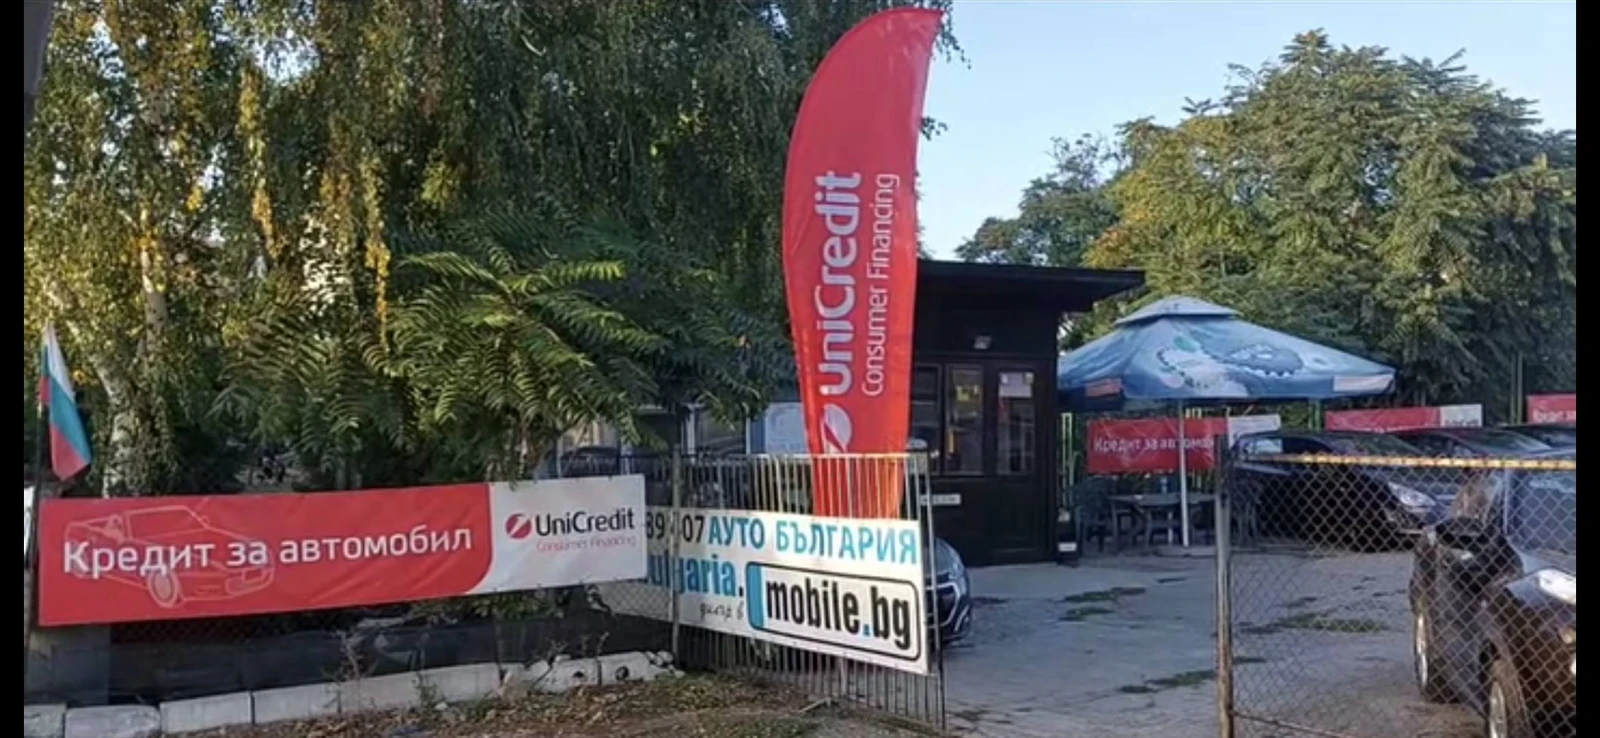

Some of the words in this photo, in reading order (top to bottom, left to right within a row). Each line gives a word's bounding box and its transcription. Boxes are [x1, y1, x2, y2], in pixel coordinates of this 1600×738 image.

[866, 173, 900, 279] Financing
[815, 170, 861, 396] UniCredit
[862, 285, 891, 397] Consumer
[63, 541, 216, 579] Кредит
[226, 541, 269, 566] за
[279, 524, 472, 563] автомобил
[535, 506, 635, 537] UniCredit
[708, 515, 765, 549] АУТО
[776, 519, 918, 565] БЪЛГАРИЯ
[766, 577, 912, 651] mobile.bg
